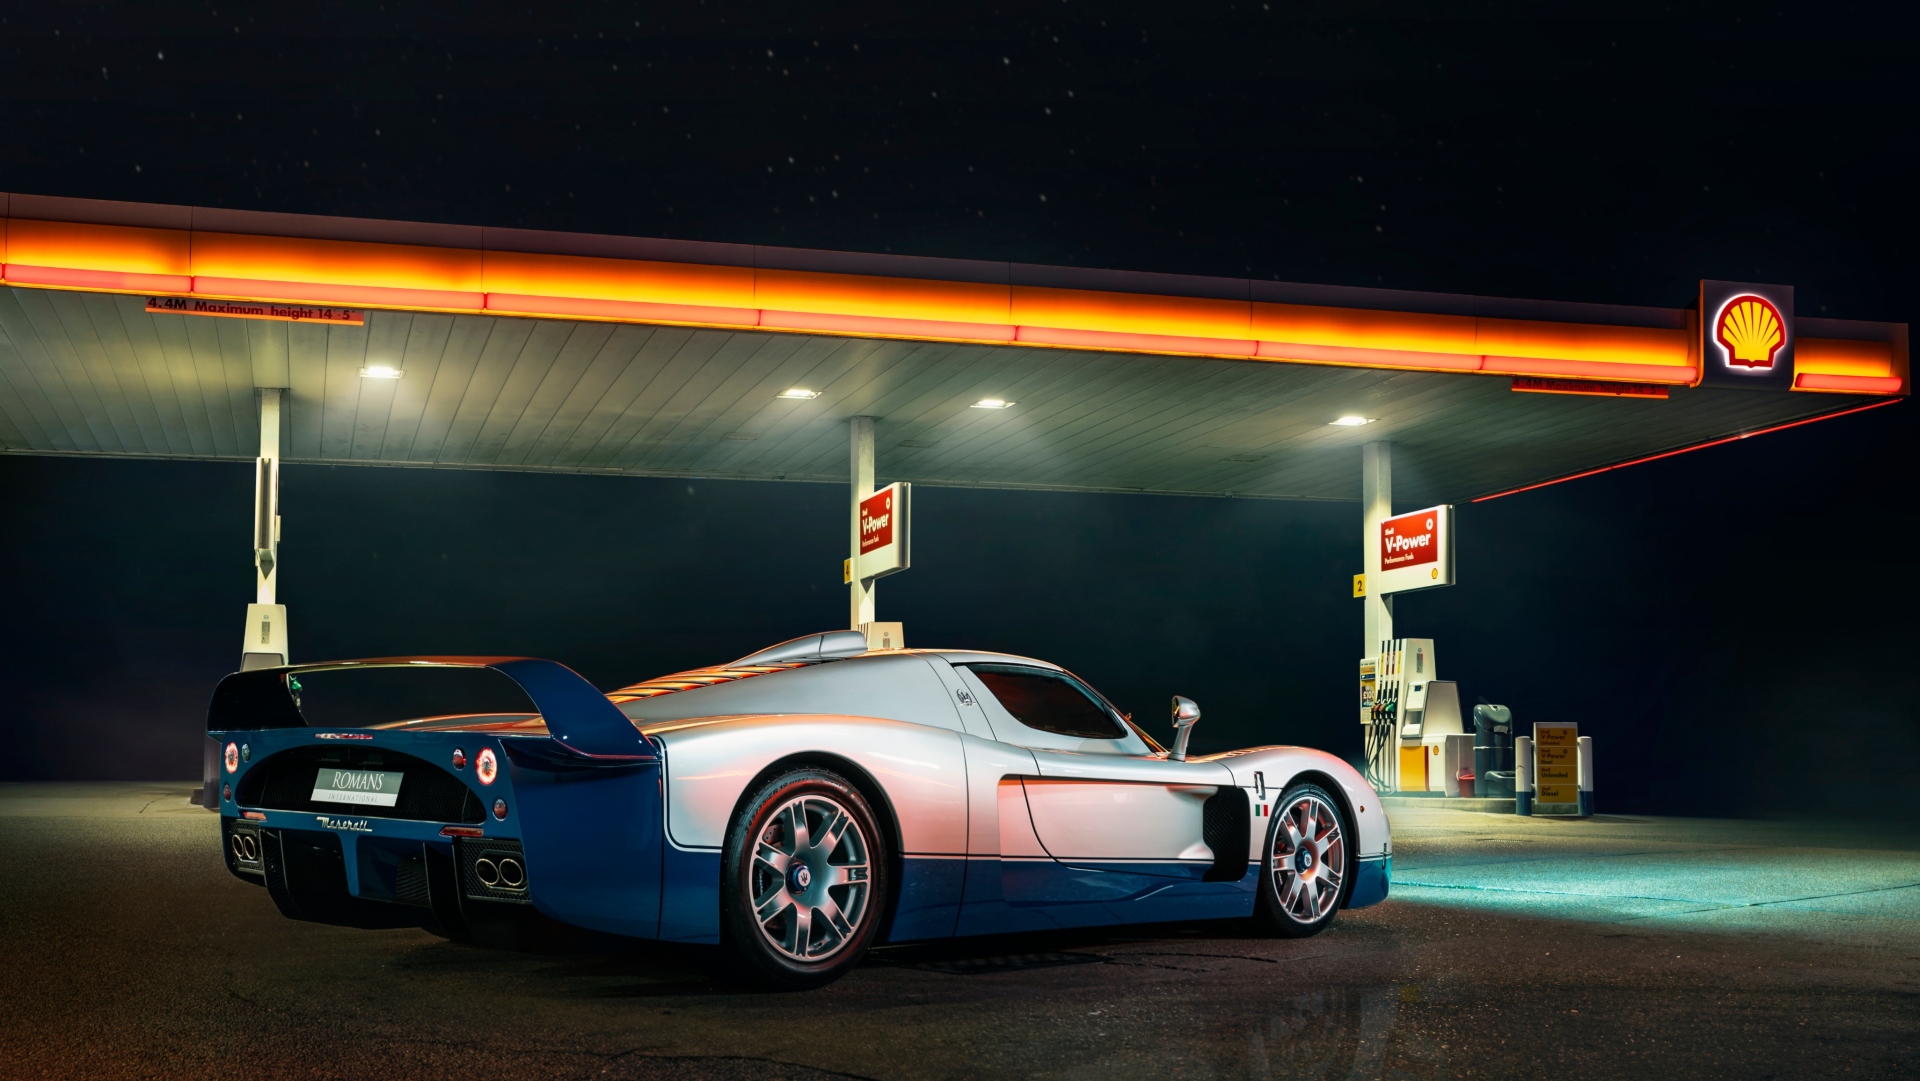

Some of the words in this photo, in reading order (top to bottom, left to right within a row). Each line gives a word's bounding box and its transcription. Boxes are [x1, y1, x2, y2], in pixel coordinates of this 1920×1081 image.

[148, 297, 187, 310] 4.4M
[194, 300, 264, 316] Maximum
[270, 305, 314, 320] height
[1546, 380, 1596, 392] Maximum
[1600, 383, 1631, 395] height
[862, 513, 889, 535] V-Power
[1385, 528, 1394, 536] Shell
[1385, 533, 1431, 554] V-Power
[1357, 580, 1363, 592] 2
[332, 771, 385, 790] ROMANS
[328, 792, 379, 803] INTERNATIONAL
[316, 816, 373, 832] Maserati
